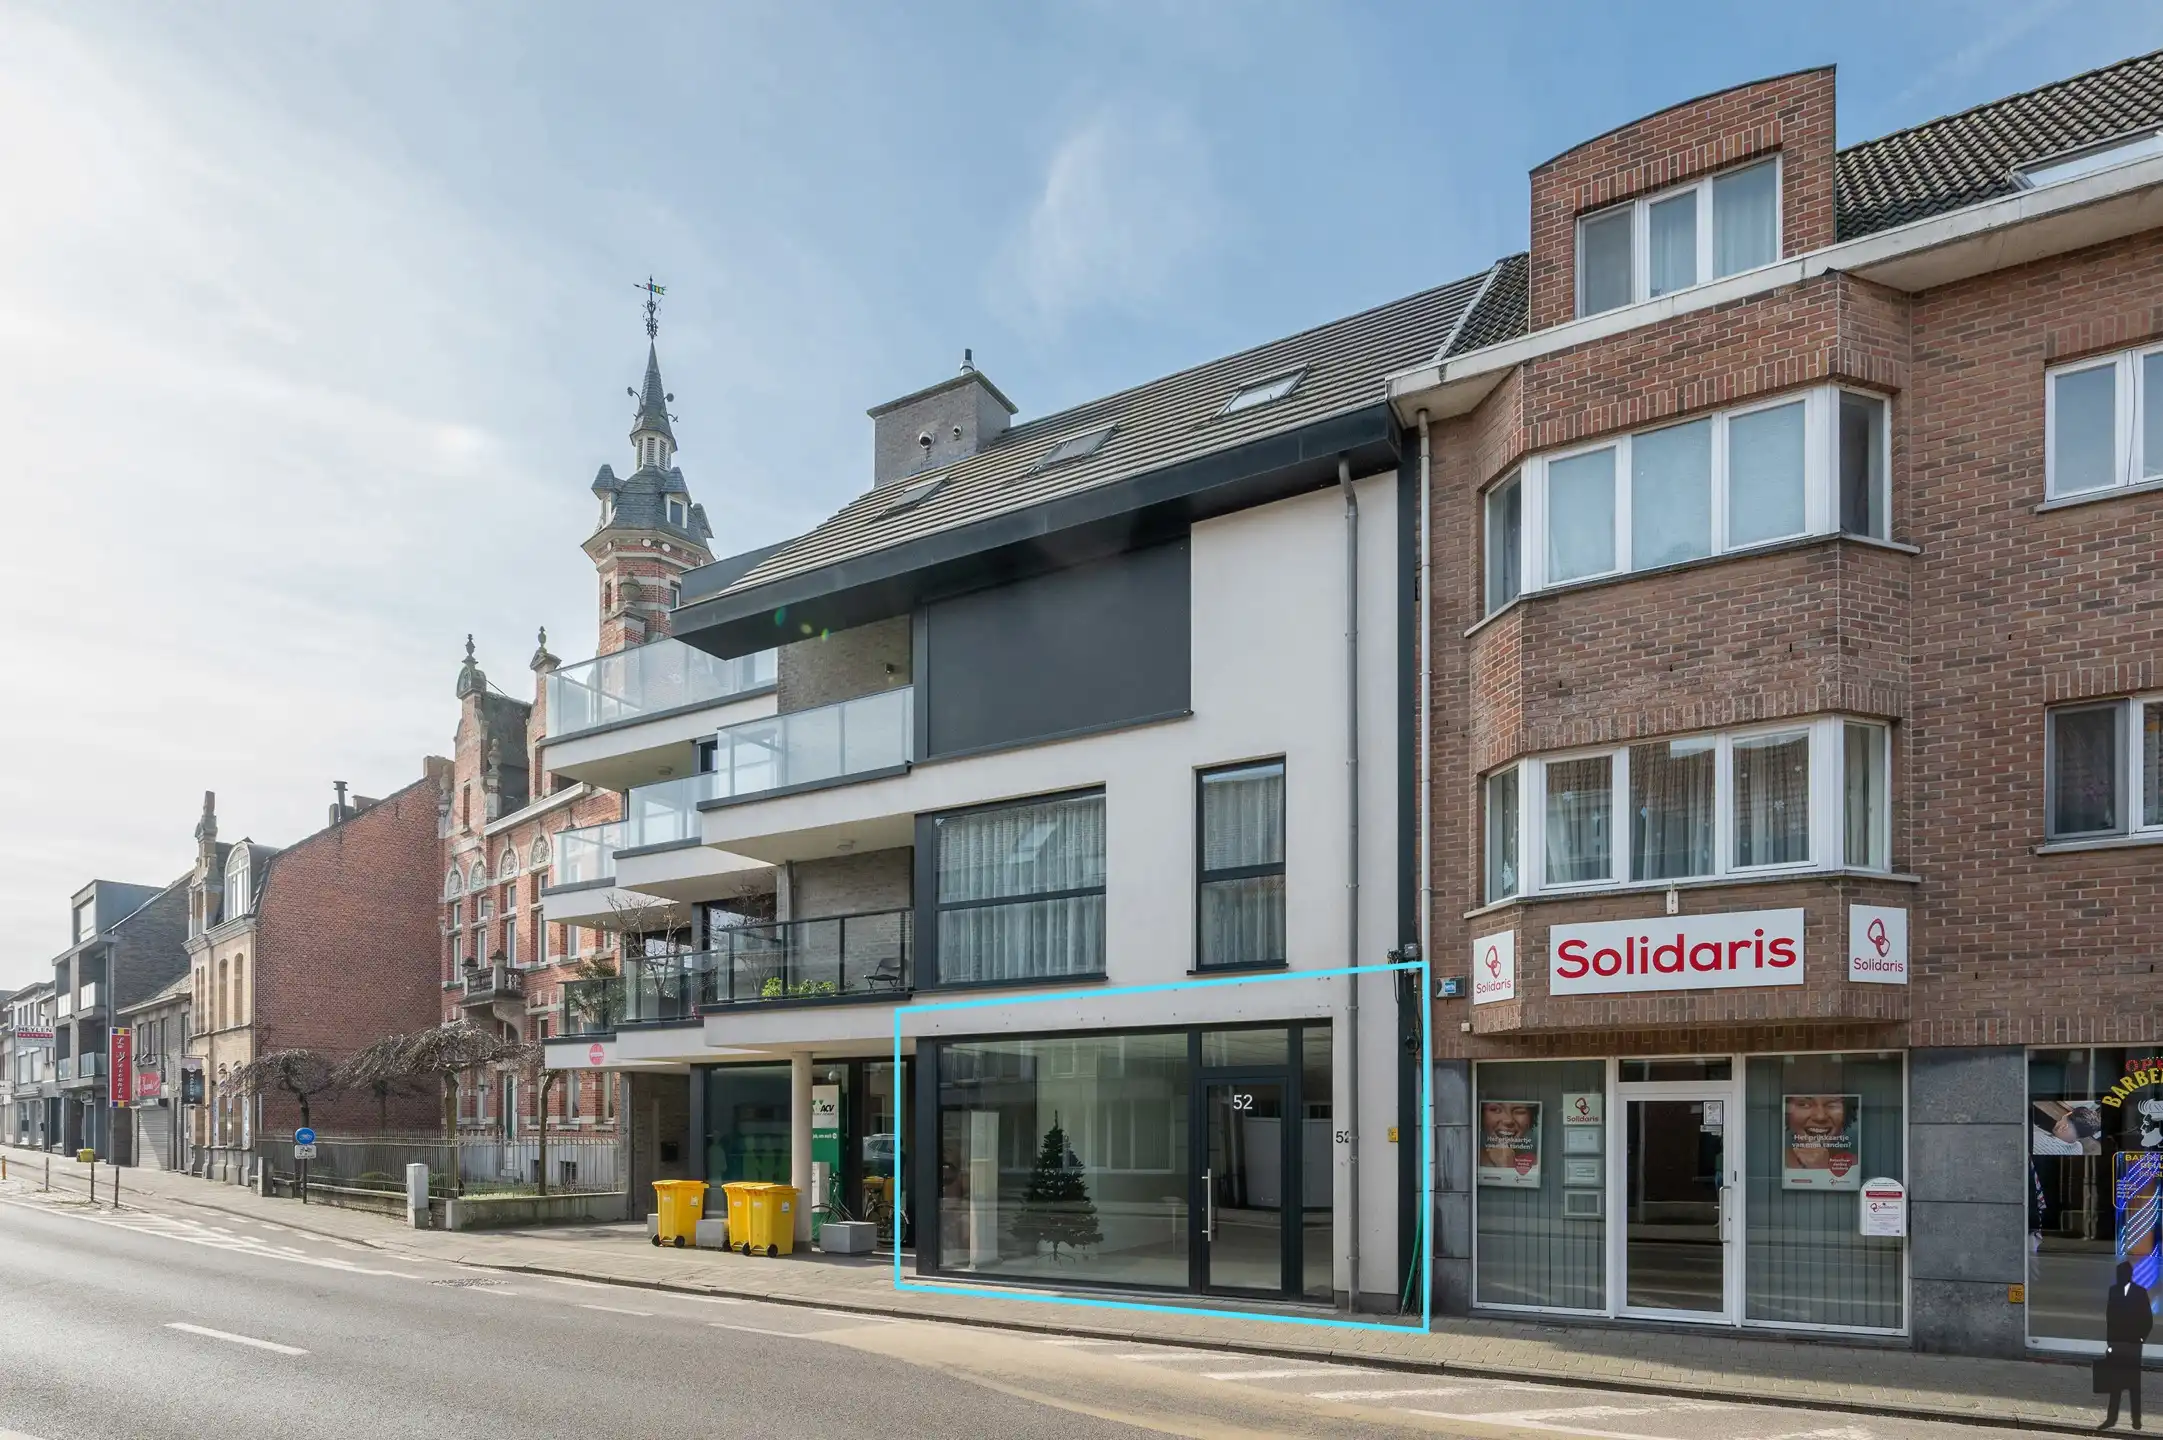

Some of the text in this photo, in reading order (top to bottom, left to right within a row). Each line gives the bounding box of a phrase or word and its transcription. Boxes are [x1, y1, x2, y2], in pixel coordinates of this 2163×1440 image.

[1556, 928, 1797, 979] Solidaris
[1853, 957, 1904, 972] Solidaris
[1476, 978, 1512, 994] Solidaris
[820, 1104, 835, 1113] ACV
[1233, 1094, 1253, 1110] 52
